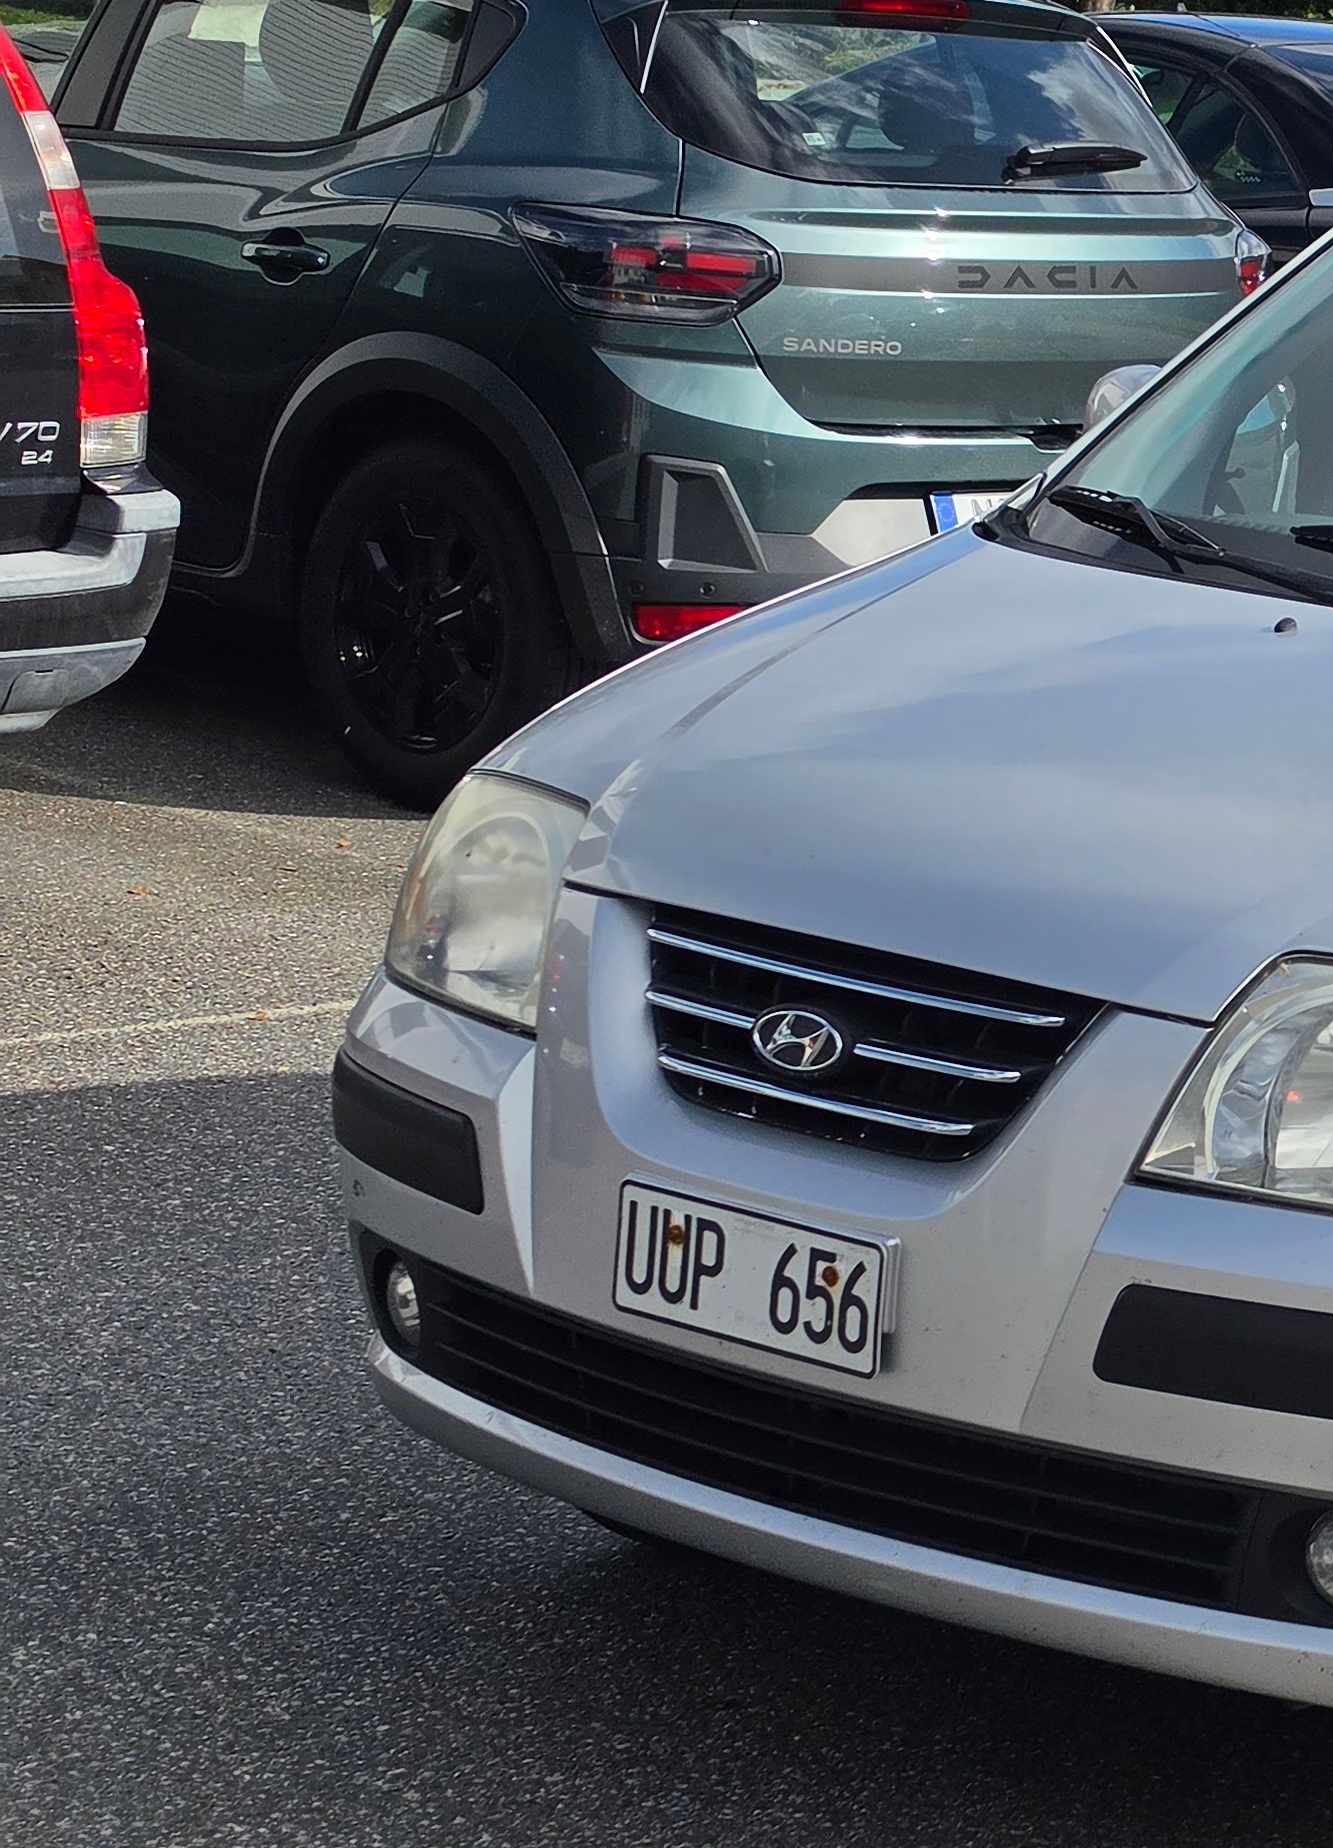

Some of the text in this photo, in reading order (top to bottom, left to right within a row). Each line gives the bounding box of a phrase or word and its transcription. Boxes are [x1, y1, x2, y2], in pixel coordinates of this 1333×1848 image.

[957, 264, 1138, 289] DACIA
[782, 337, 902, 355] SANDERO
[624, 1199, 869, 1354] UUP 656
